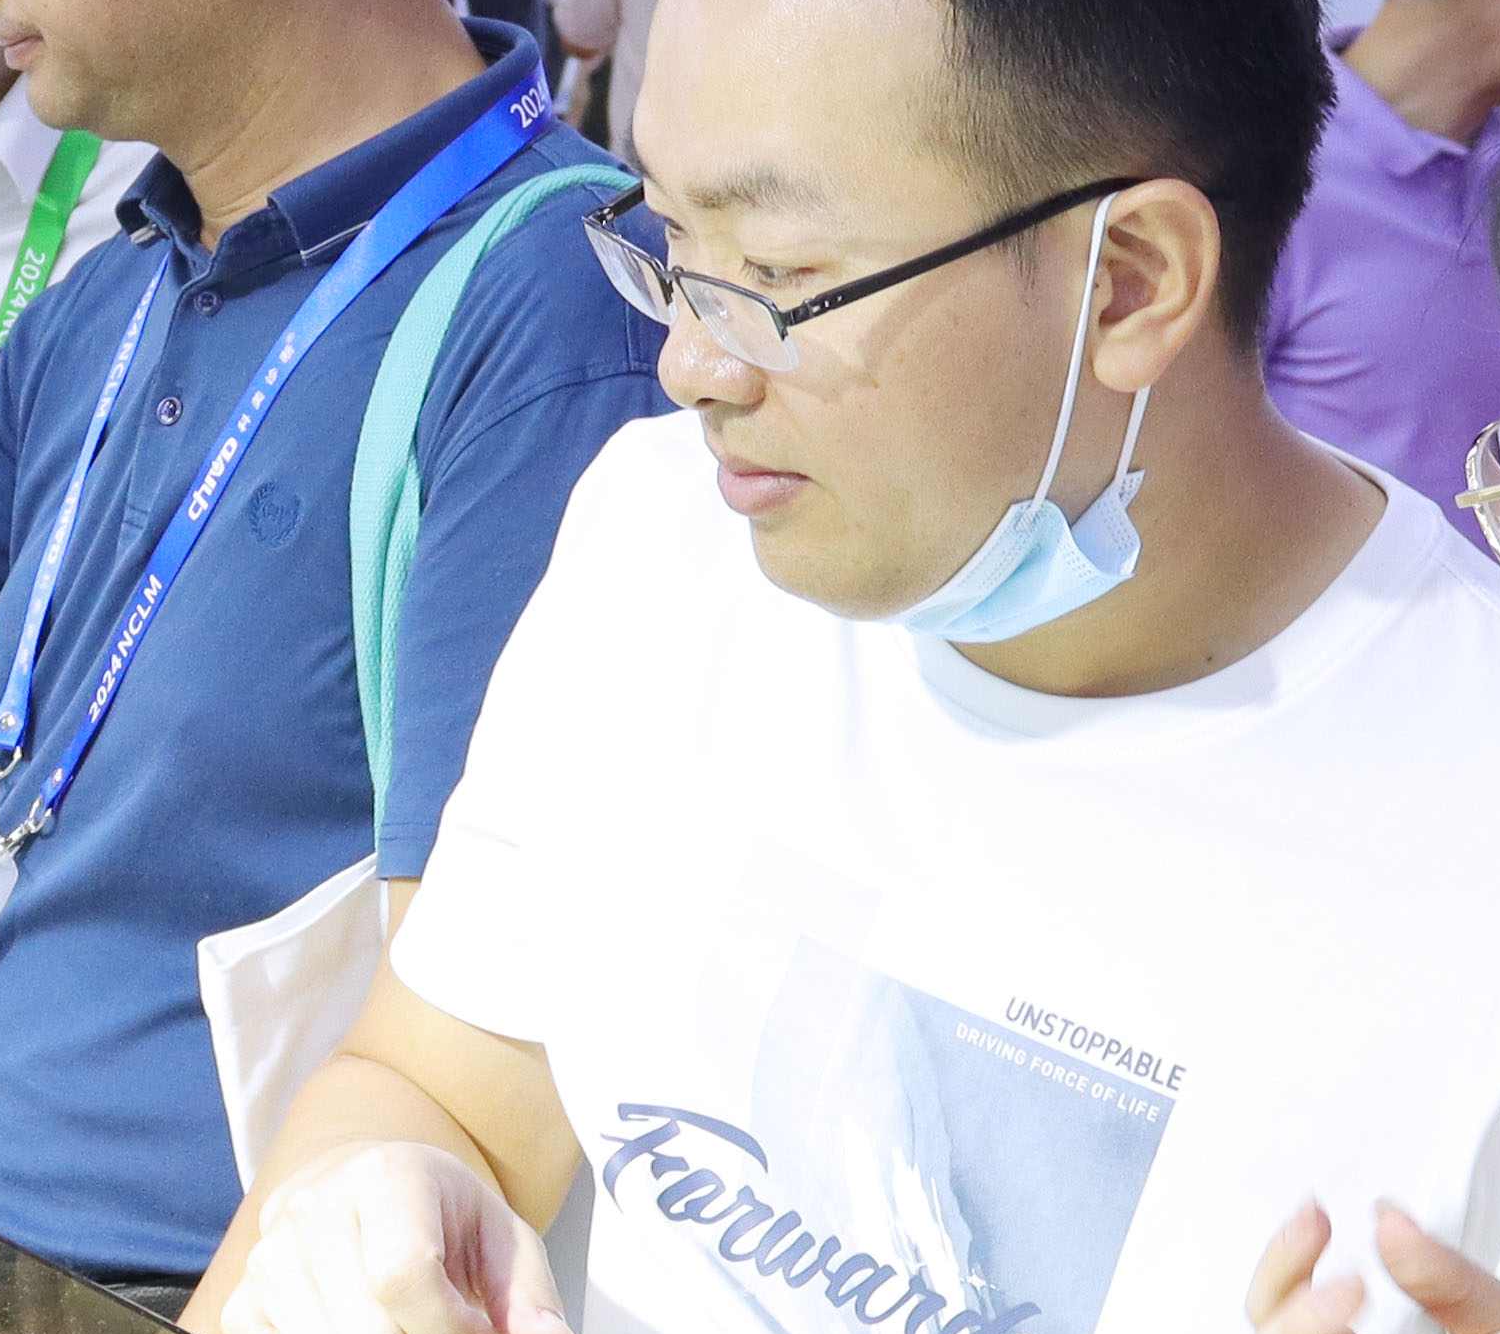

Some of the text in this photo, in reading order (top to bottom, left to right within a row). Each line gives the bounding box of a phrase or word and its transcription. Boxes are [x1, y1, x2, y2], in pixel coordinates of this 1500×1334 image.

[956, 1022, 1161, 1123] DRIVING FORCE OF LIFE
[1005, 997, 1186, 1091] UNSTOPPABLE
